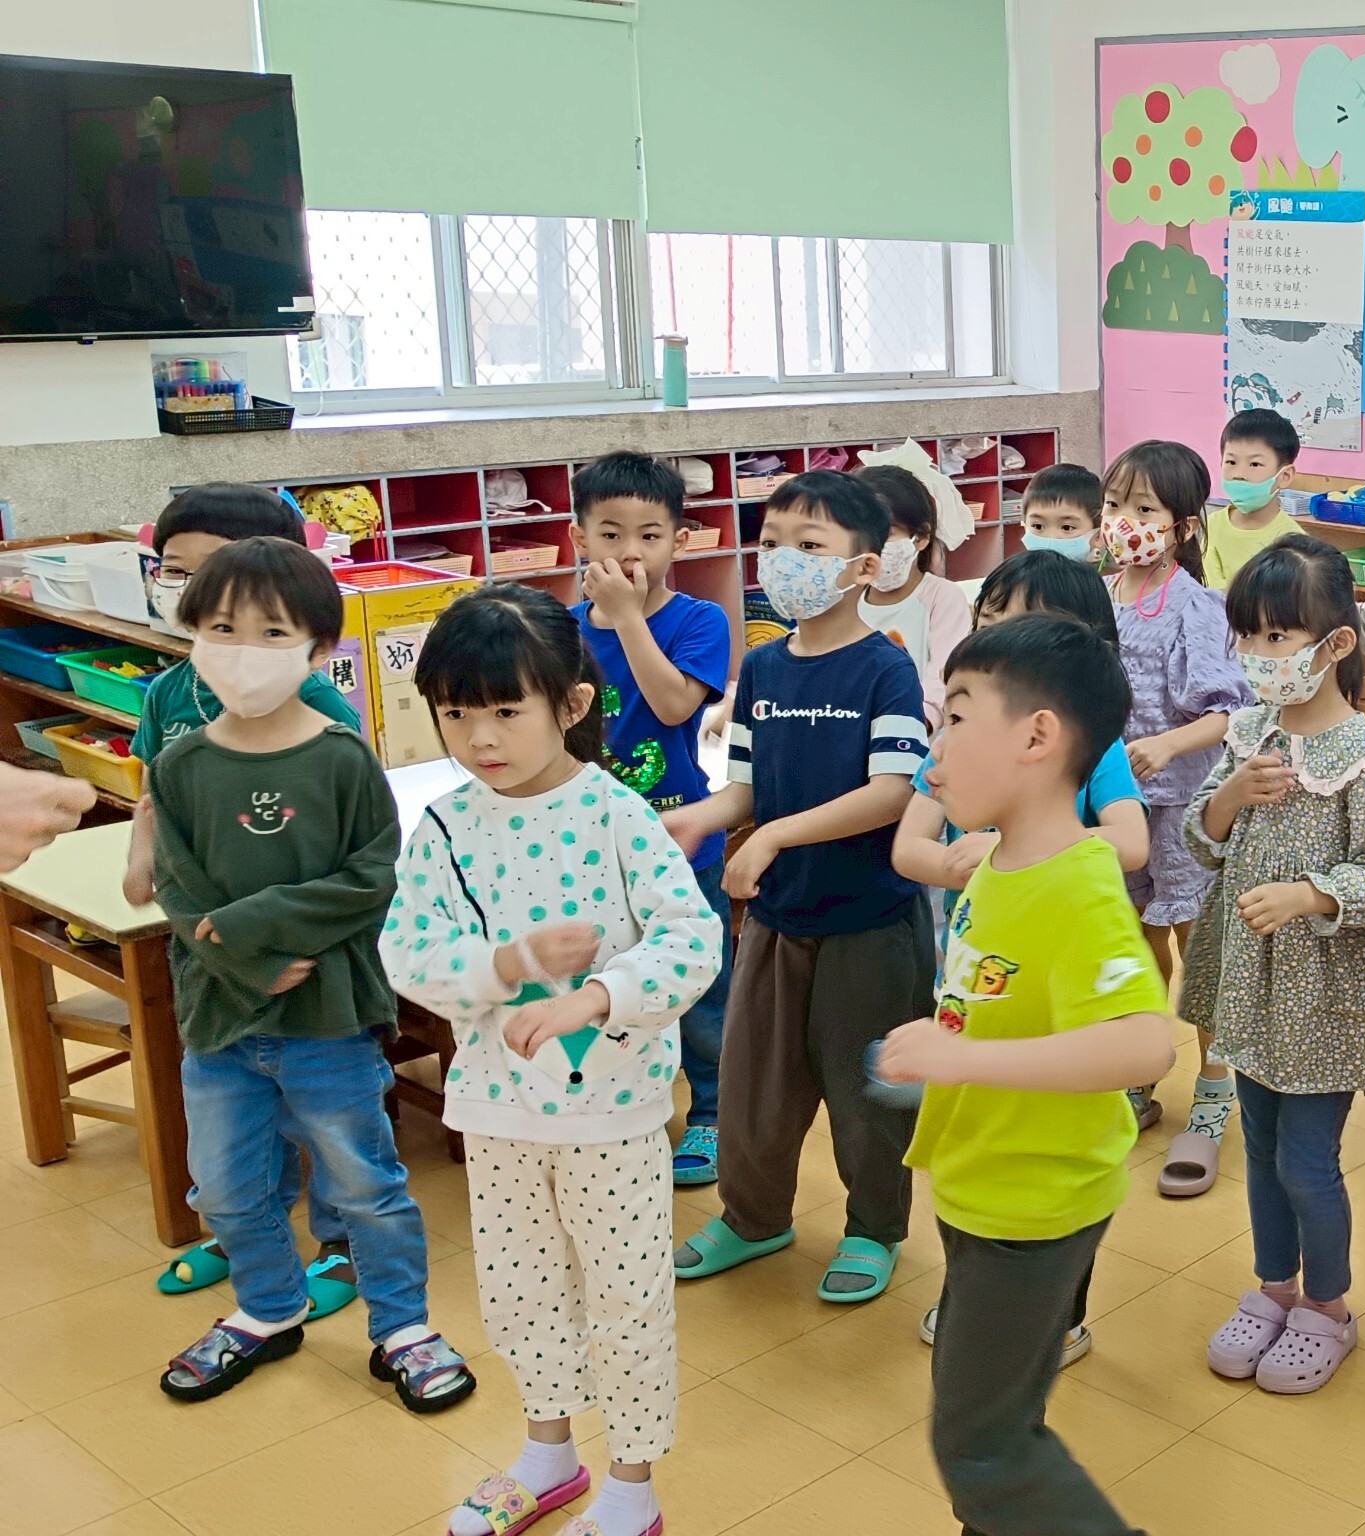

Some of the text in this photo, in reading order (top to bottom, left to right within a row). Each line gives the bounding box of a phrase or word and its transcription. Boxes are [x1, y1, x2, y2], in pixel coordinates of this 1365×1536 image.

[386, 640, 415, 670] 扮
[332, 659, 355, 687] 構
[752, 699, 861, 726] Champion
